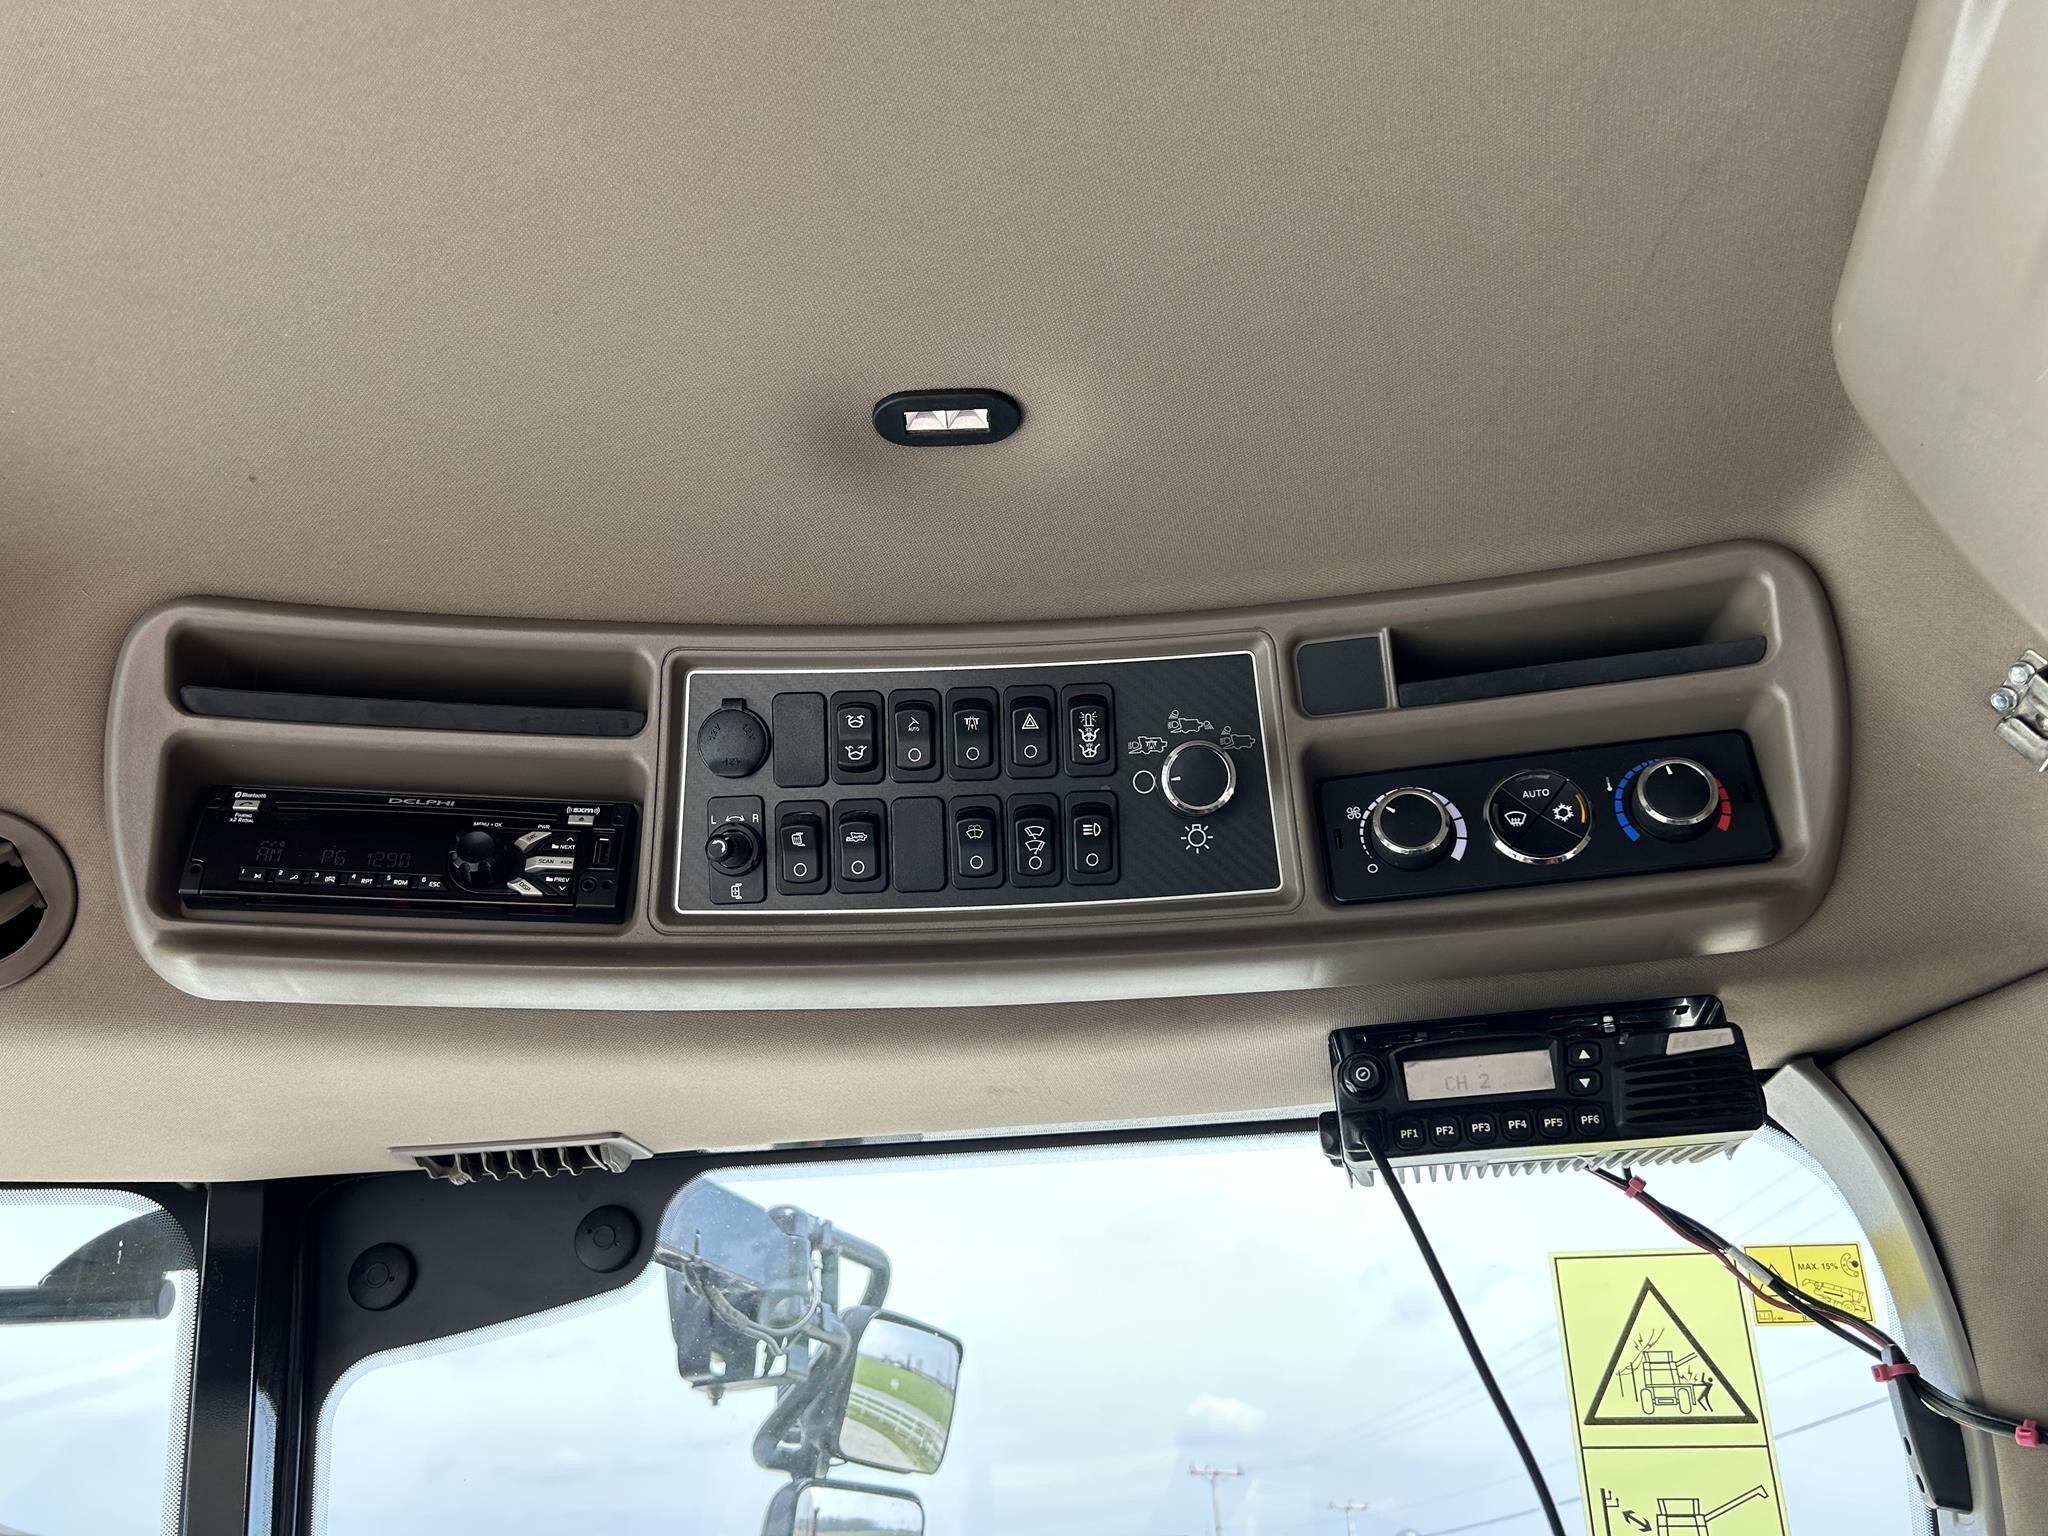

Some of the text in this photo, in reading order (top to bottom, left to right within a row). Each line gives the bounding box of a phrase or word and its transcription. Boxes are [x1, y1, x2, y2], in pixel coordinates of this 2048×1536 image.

[1522, 788, 1550, 799] AUTO
[388, 797, 455, 807] DELPHI
[710, 815, 717, 825] L
[752, 813, 759, 823] R
[367, 851, 411, 868] 1290
[1444, 1073, 1490, 1092] CH 2
[1507, 1119, 1527, 1130] PF4
[1543, 1117, 1563, 1128] PF5
[1580, 1114, 1600, 1125] PF6
[1400, 1128, 1419, 1139] PF1
[1435, 1125, 1455, 1136] PF2
[1471, 1122, 1491, 1134] PF3
[1797, 1262, 1839, 1271] MAX. 15%
